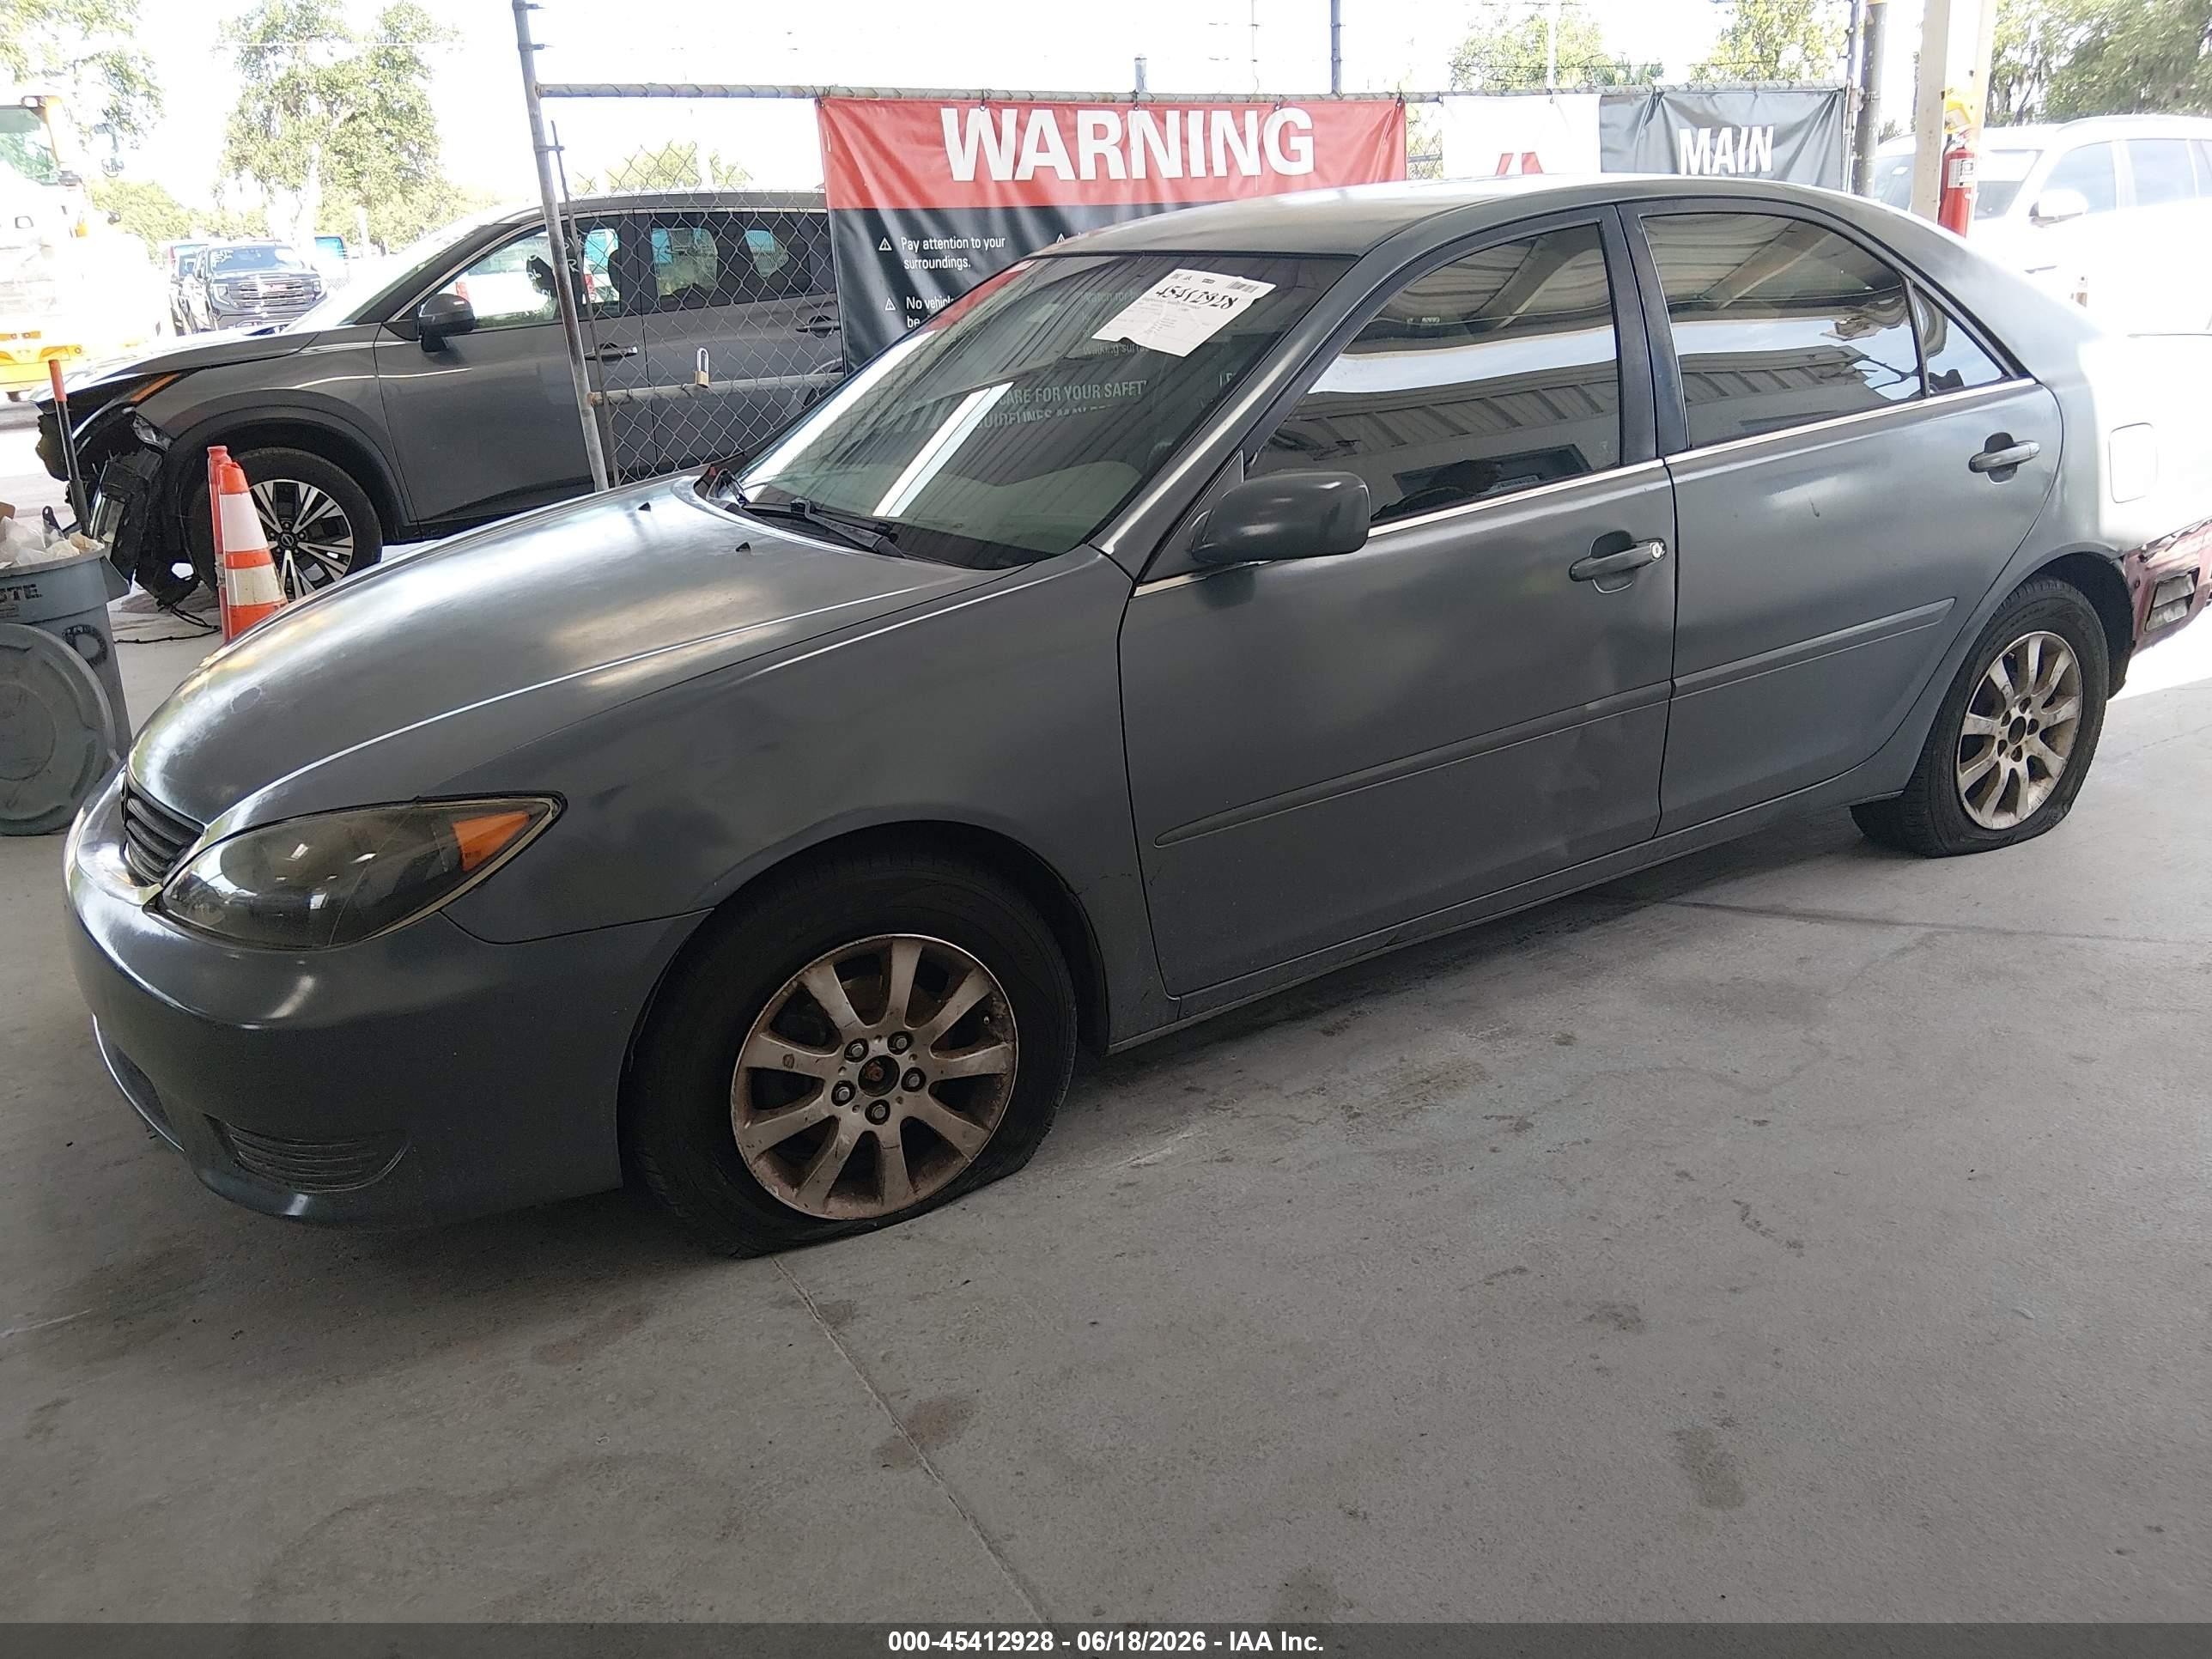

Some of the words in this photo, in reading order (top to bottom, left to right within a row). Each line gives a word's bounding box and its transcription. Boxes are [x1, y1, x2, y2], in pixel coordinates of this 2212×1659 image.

[940, 106, 1315, 181] WARNING
[1679, 125, 1774, 175] MAIN
[901, 237, 920, 253] Pay
[922, 236, 969, 250] attention
[971, 237, 981, 249] to
[983, 238, 1006, 251] your
[903, 255, 971, 270] surroundings.
[906, 296, 923, 310] No
[924, 295, 954, 310] vehicl
[907, 315, 921, 328] be
[1035, 386, 1061, 403] FOR
[1063, 384, 1101, 401] YOUR
